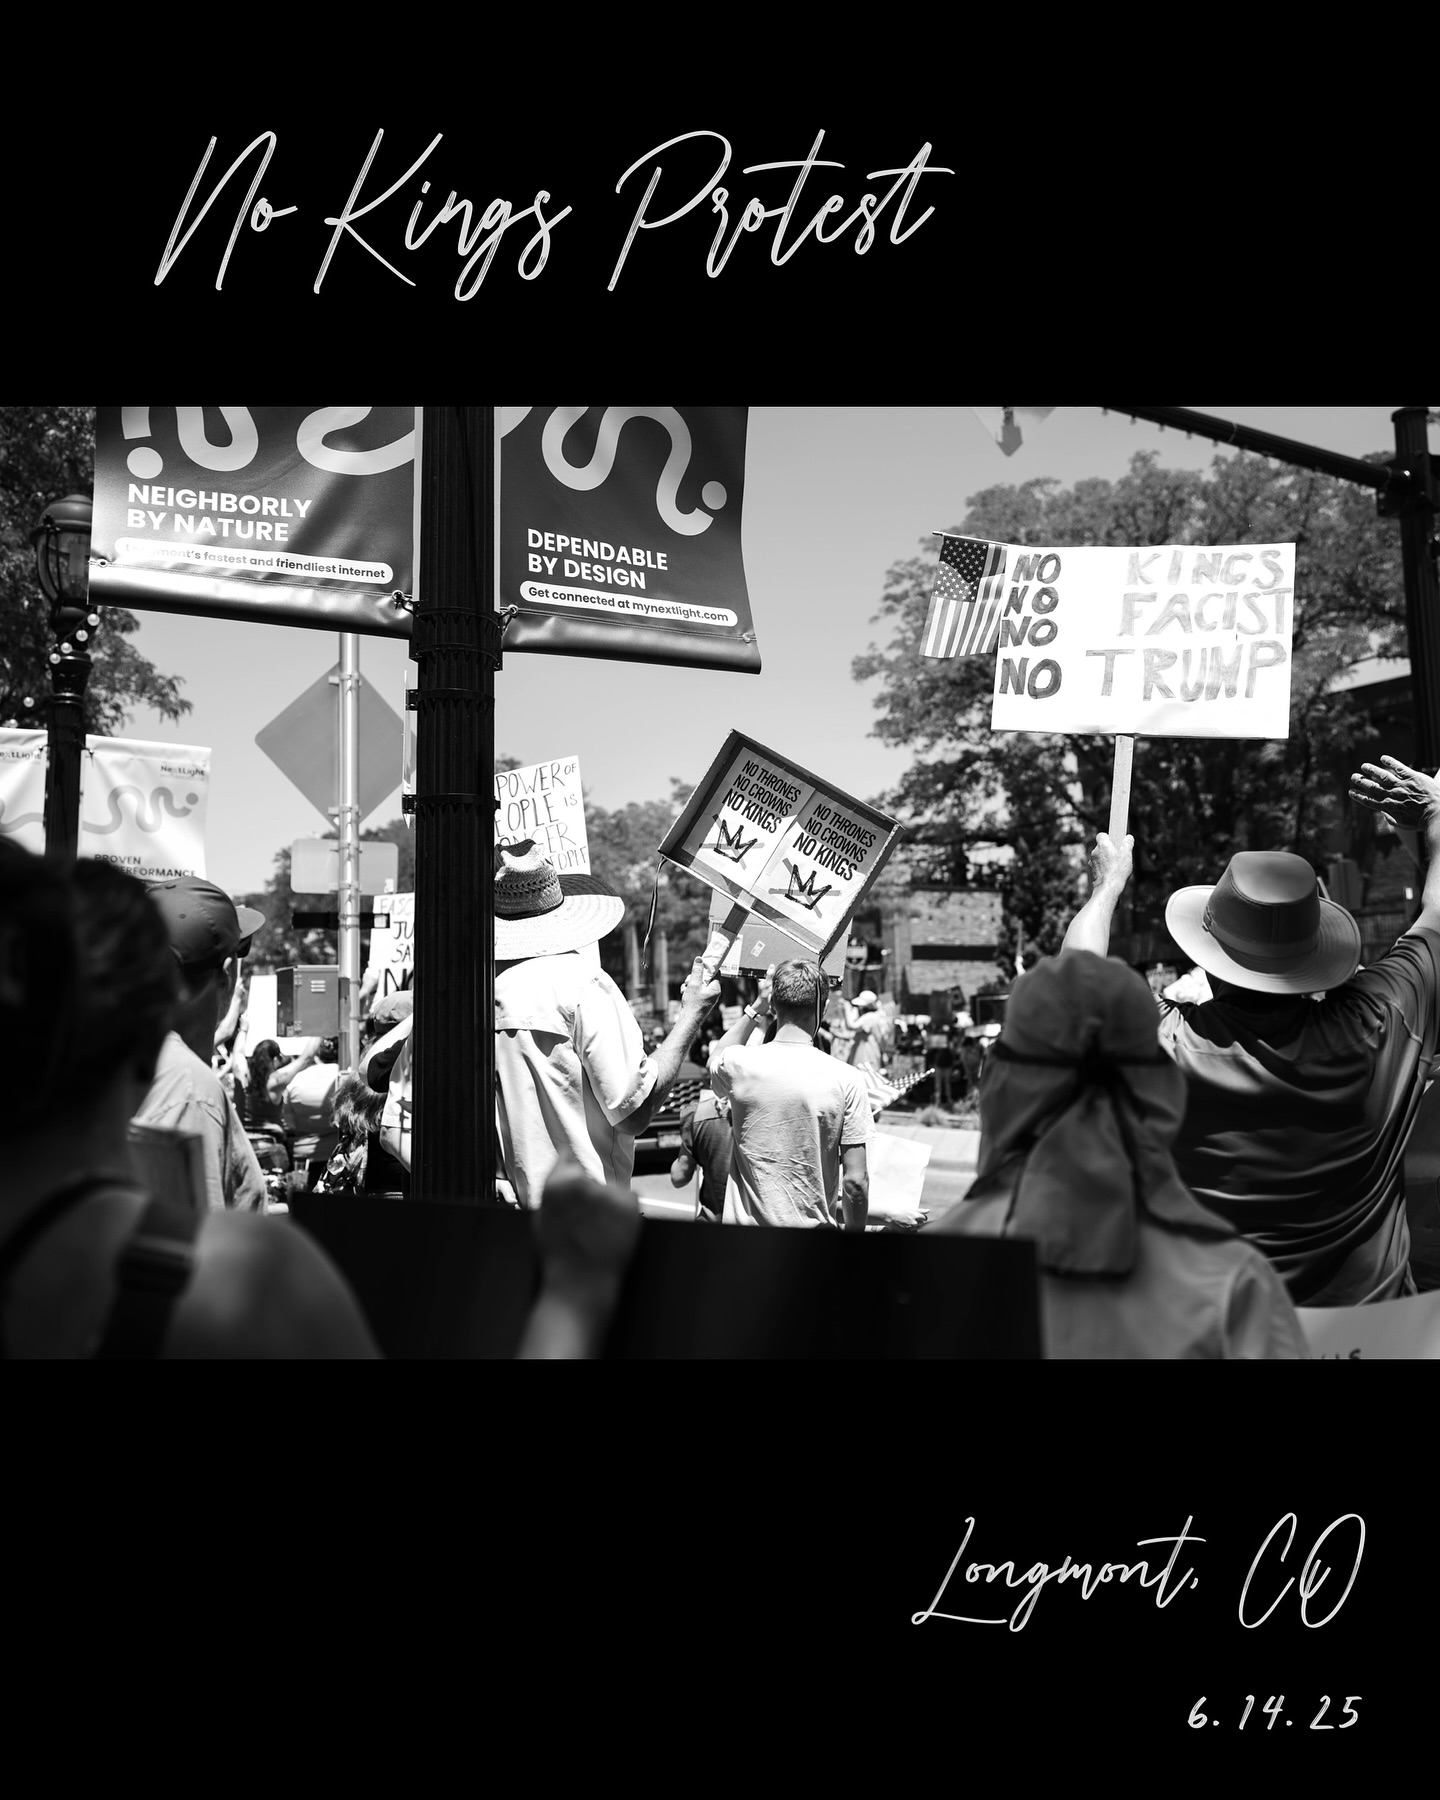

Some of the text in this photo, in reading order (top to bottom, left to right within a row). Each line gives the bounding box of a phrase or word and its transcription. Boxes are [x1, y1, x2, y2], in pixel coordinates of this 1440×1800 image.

[128, 483, 312, 518] NEIGHBORLY
[127, 508, 289, 542] BY NATURE
[203, 551, 247, 565] fastest
[249, 557, 273, 567] and
[276, 557, 337, 574] friendliest
[338, 564, 386, 578] internet
[527, 528, 668, 571] DEPENDABLE
[1011, 549, 1285, 589] NO KINGS
[528, 552, 646, 590] BY DESIGN
[528, 586, 729, 622] Get connected at mynextlight.com
[1003, 585, 1293, 636] NO FACIST
[999, 616, 1058, 648] NO
[998, 639, 1287, 702] NO TRUMP
[495, 762, 577, 801] POWER OF
[564, 793, 578, 807] IS
[733, 773, 792, 817] NO CROWNS
[741, 760, 801, 803] NO THRONES
[721, 788, 782, 833] NO KINGS
[812, 803, 876, 848] NO THRONES
[94, 854, 142, 865] PROVEN
[792, 832, 858, 881] NO KINGS
[803, 817, 867, 863] NO CROWNS
